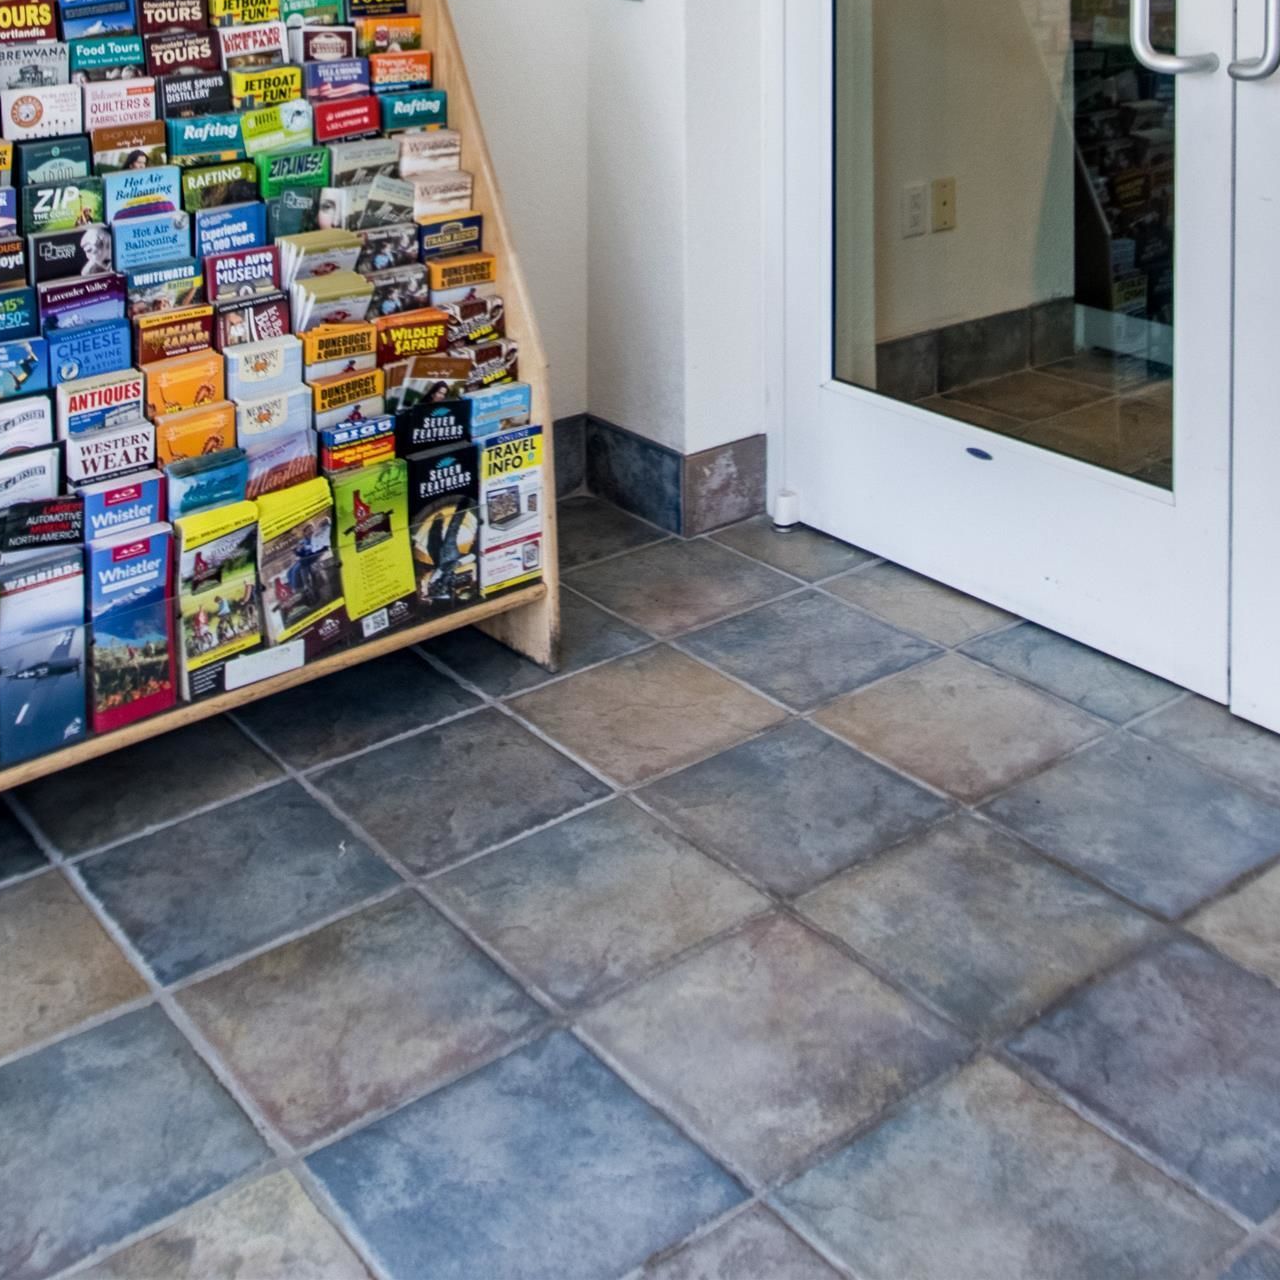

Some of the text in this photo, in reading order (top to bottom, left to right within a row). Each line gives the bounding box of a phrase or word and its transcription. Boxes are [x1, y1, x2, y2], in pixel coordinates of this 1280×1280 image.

[143, 0, 174, 10] Chocolate
[242, 8, 269, 20] FUN!
[144, 7, 202, 24] TOURS
[76, 42, 140, 56] Food Tours
[151, 39, 183, 51] Chocolate
[185, 37, 210, 48] Factory
[225, 40, 249, 53] BIKE
[152, 44, 211, 66] TOURS
[166, 76, 224, 94] HOUSE SPIRITS
[244, 74, 296, 92] JETBOAT
[167, 88, 210, 103] DISTILLERY
[263, 88, 292, 101] FUN!
[91, 99, 141, 114] QUILTERS
[143, 97, 151, 106] &
[394, 99, 440, 116] Rafting
[184, 123, 238, 141] Rafting
[124, 174, 163, 188] Hot Air
[188, 166, 242, 189] RAFTING
[34, 186, 80, 212] ZIP
[116, 183, 173, 201] Ballooning
[133, 224, 169, 239] Hot Air
[201, 222, 248, 242] Experience
[232, 233, 255, 247] Years
[125, 234, 179, 251] Ballooning
[216, 252, 273, 271] AIR AUTO
[133, 265, 195, 286] WHITEWATER
[216, 264, 273, 285] MUSEUM
[47, 281, 109, 303] Lavender Valley
[318, 331, 371, 351] DUNEBUGGY
[390, 325, 445, 342] WILDLIFE
[57, 331, 121, 358] CHEESE
[344, 341, 372, 355] RENTALS
[395, 336, 439, 355] SAFARI
[94, 349, 121, 361] WINE
[321, 375, 376, 400] DUNEBUGGY
[348, 387, 376, 402] RENTALS
[68, 381, 141, 413] ANTIQUES
[80, 431, 151, 456] WESTERN
[486, 438, 536, 462] TRAVEL
[81, 446, 150, 476] WEAR
[488, 456, 523, 476] INFO
[26, 512, 82, 526] AUTOMOTIVE
[71, 521, 81, 529] IN
[91, 504, 154, 529] Whistler
[9, 529, 80, 547] NORTH AMERICA
[4, 562, 81, 592] WARBIRDS
[99, 558, 161, 585] Whistler
